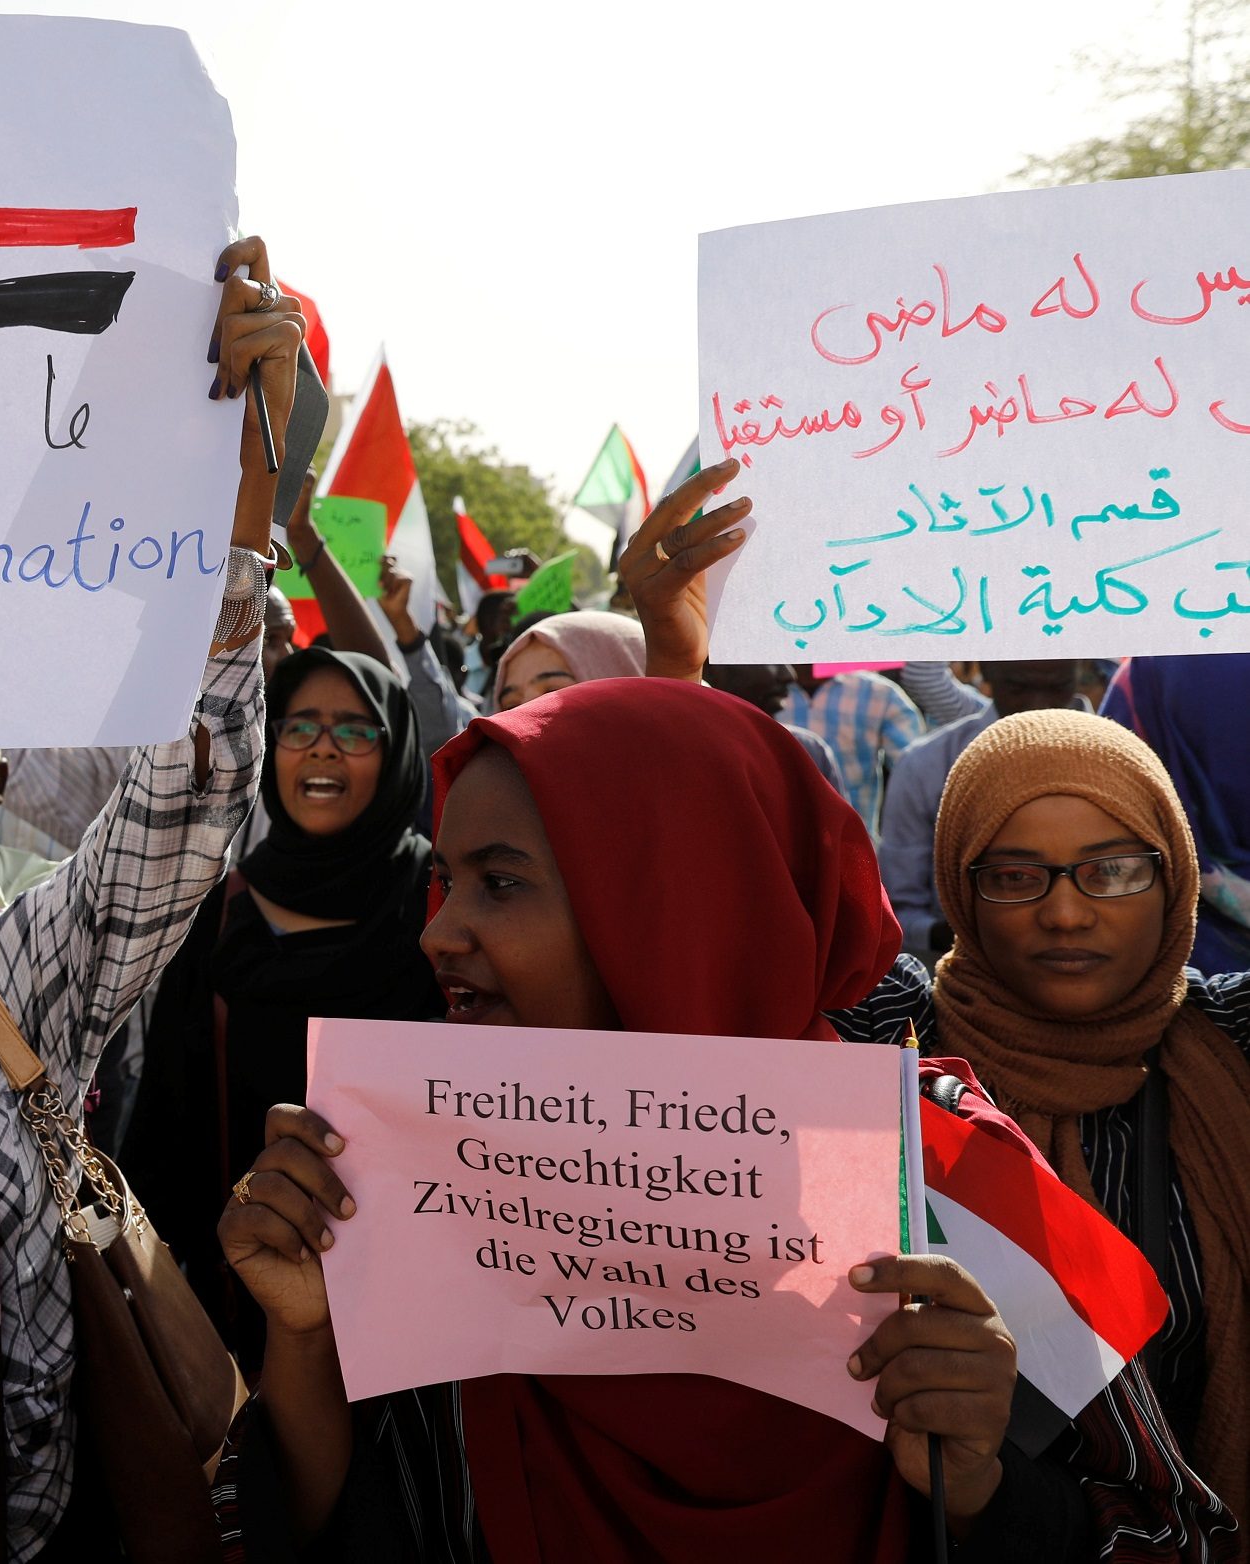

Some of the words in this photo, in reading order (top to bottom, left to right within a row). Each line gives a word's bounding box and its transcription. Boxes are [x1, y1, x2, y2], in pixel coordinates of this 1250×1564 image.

[1030, 252, 1101, 320] له
[44, 353, 91, 450] le
[851, 362, 933, 459] أو
[1103, 356, 1180, 420] له
[1070, 466, 1182, 542] قسم
[1018, 527, 1224, 638] كلية
[423, 1078, 608, 1134] Freiheit,
[624, 1089, 791, 1145] Friede,
[456, 1137, 764, 1202] Gerechtigkeit
[413, 1180, 751, 1264] Zivielregierung
[767, 1223, 825, 1265] ist
[475, 1238, 538, 1276] die
[547, 1250, 669, 1289] Wahl
[684, 1267, 762, 1299] des
[540, 1295, 698, 1333] Volkes
